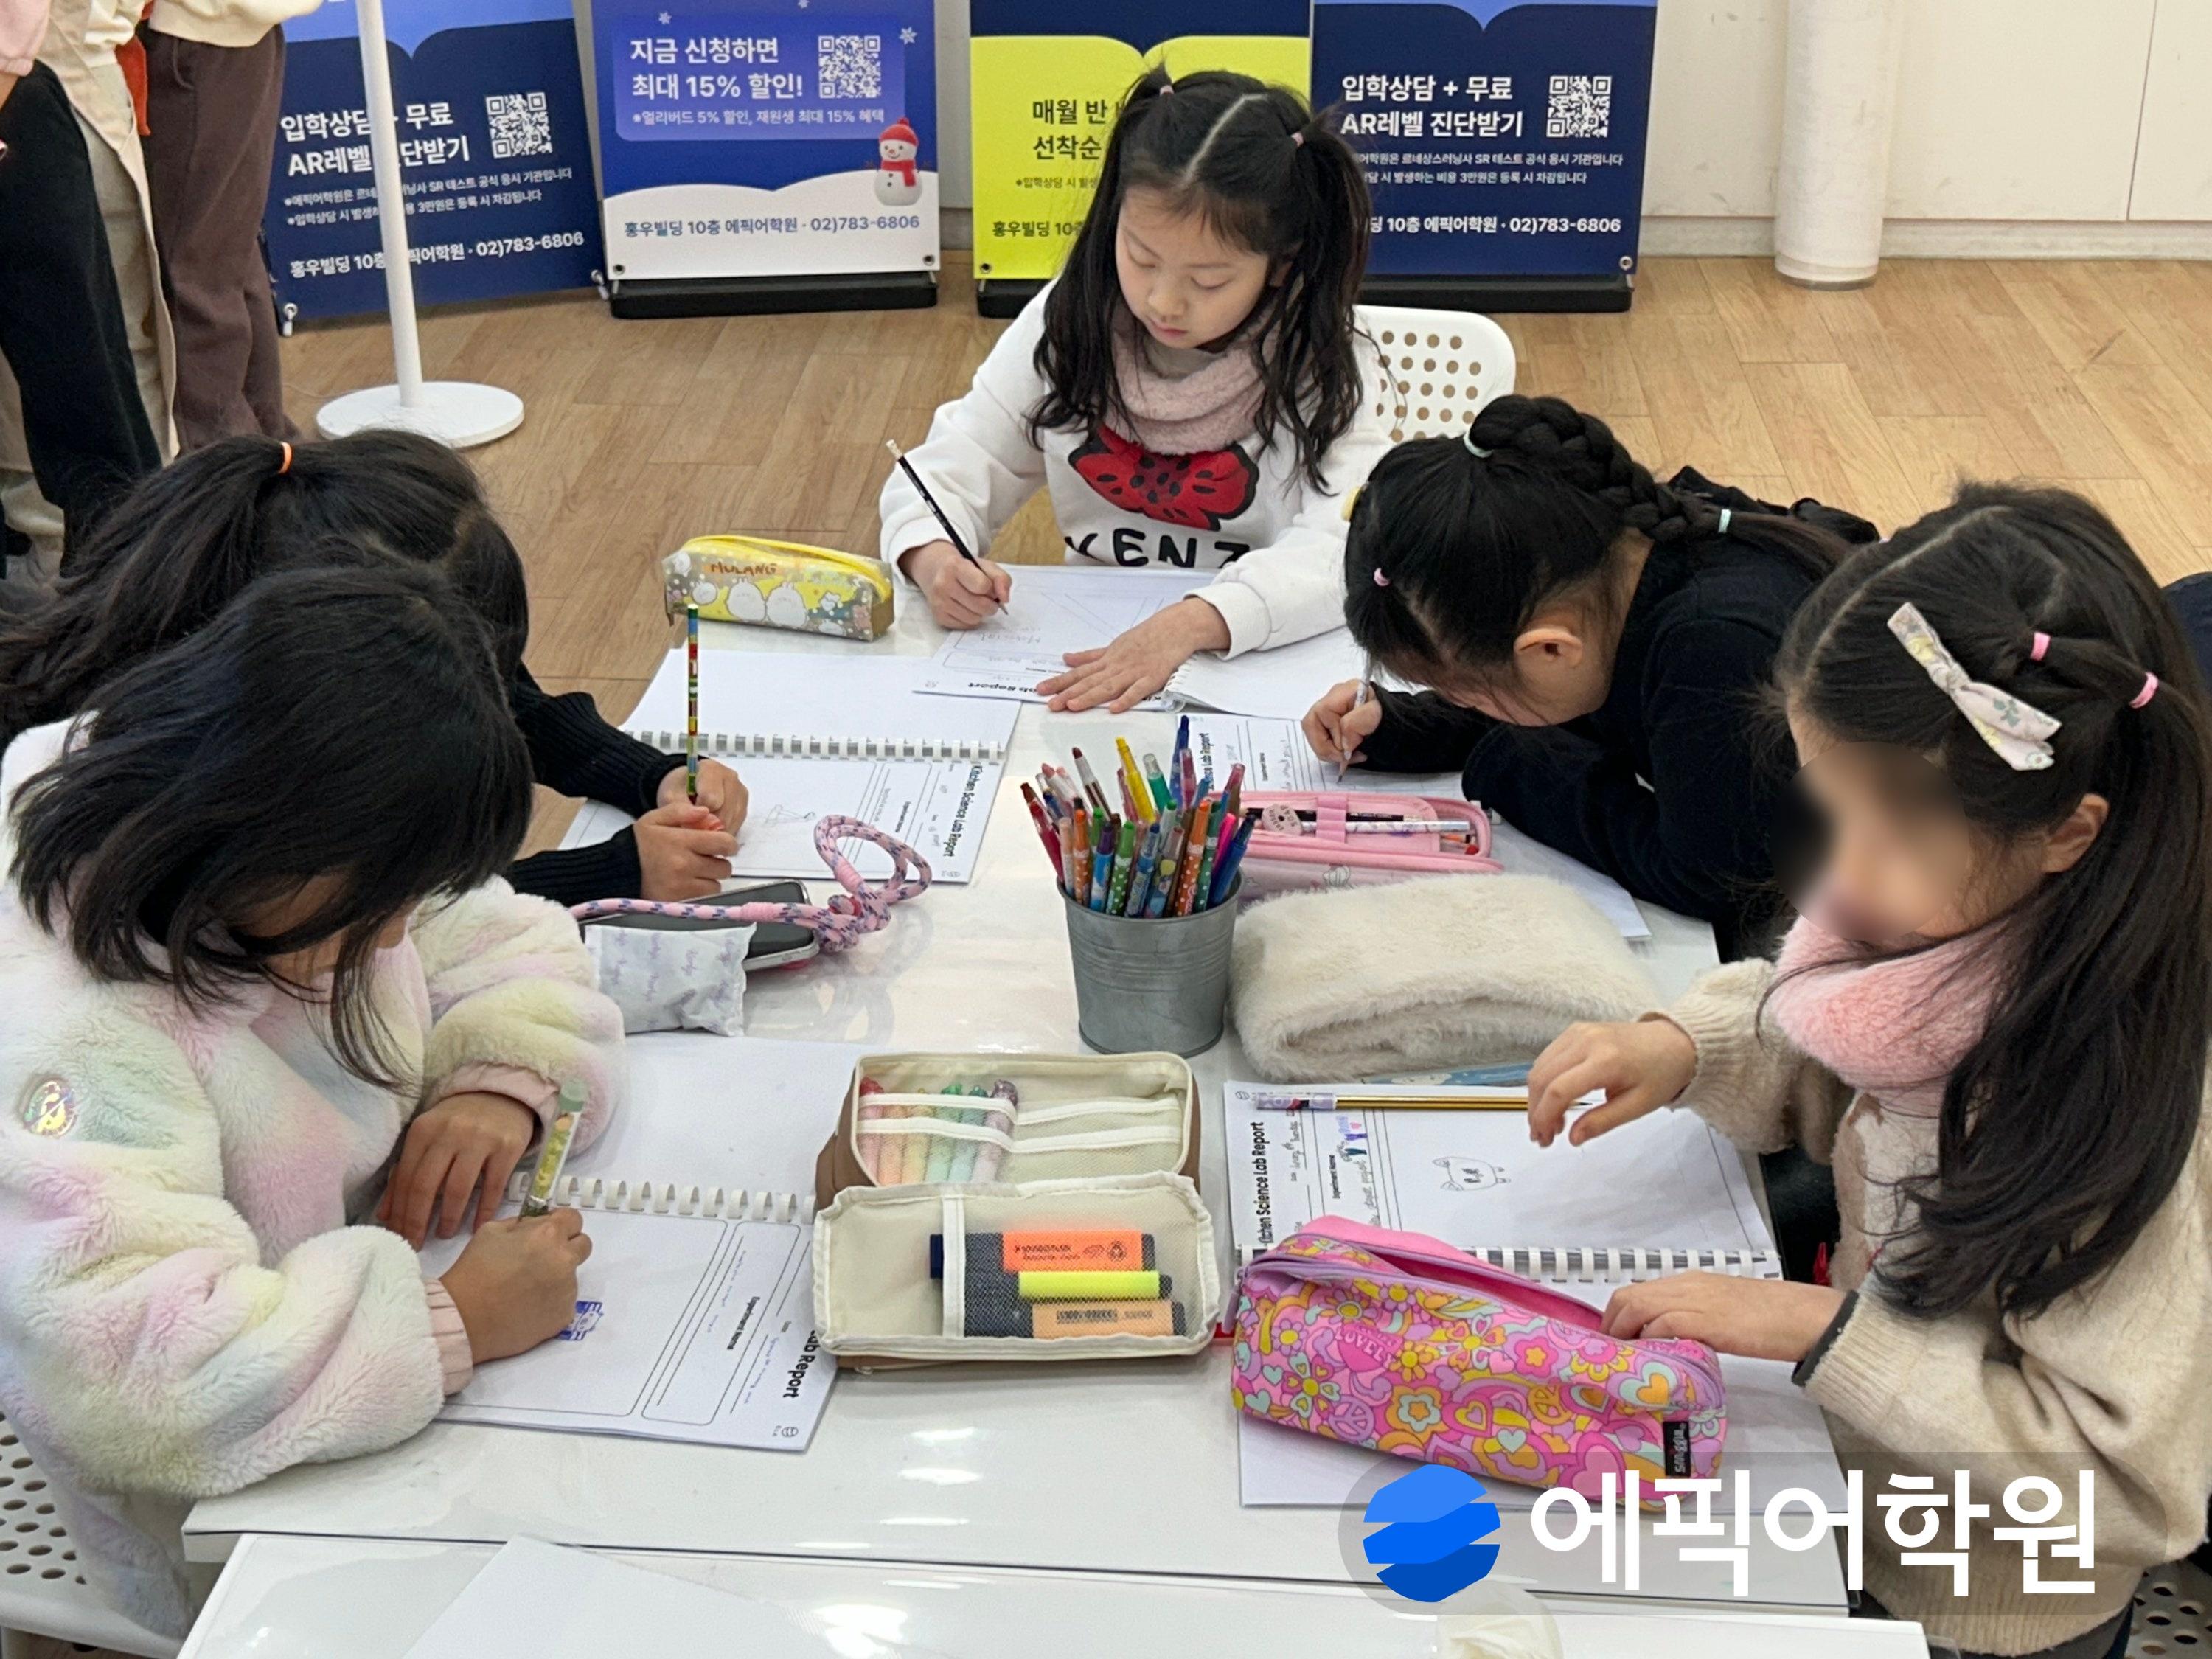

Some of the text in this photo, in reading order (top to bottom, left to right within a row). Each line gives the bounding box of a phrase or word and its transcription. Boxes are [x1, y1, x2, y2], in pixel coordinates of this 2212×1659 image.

[630, 37, 779, 65] 지금 신청하면
[633, 73, 803, 100] 최대 15% 할인!
[1341, 74, 1512, 102] 입학상담 + 무료
[406, 102, 453, 130] 무료
[698, 111, 720, 125] 5%
[757, 109, 795, 125] 재원생
[798, 109, 824, 124] 최대
[827, 110, 855, 123] 15%
[859, 109, 884, 124] 혜택
[1032, 99, 1108, 125] 매월 반
[1340, 111, 1523, 138] AR레벨 진단받기
[288, 136, 470, 176] AR레벨 단받기
[1033, 135, 1102, 161] 선착순
[1475, 153, 1490, 164] SR
[1492, 153, 1523, 165] 테스트
[1526, 153, 1546, 166] 공식
[1572, 153, 1623, 166] 기관입니다
[1460, 171, 1498, 184] 3만원은
[1523, 171, 1534, 184] 시
[624, 215, 921, 238] 홍우빌딩 10층 에픽어학원 02)783-6806
[992, 220, 1050, 237] 홍우빌딩
[1387, 216, 1420, 234] 10층
[1424, 215, 1497, 234] 에픽어학원
[1509, 218, 1621, 235] 02)783-6806
[409, 243, 465, 265] 픽어학원
[476, 232, 585, 258] 02)783-6806
[1250, 1121, 1270, 1156] Report
[1252, 1157, 1267, 1175] Lab
[1253, 1176, 1270, 1215] Science
[803, 1329, 821, 1353] ab
[1335, 1326, 1396, 1369] LOVELY
[782, 1354, 816, 1398] Report
